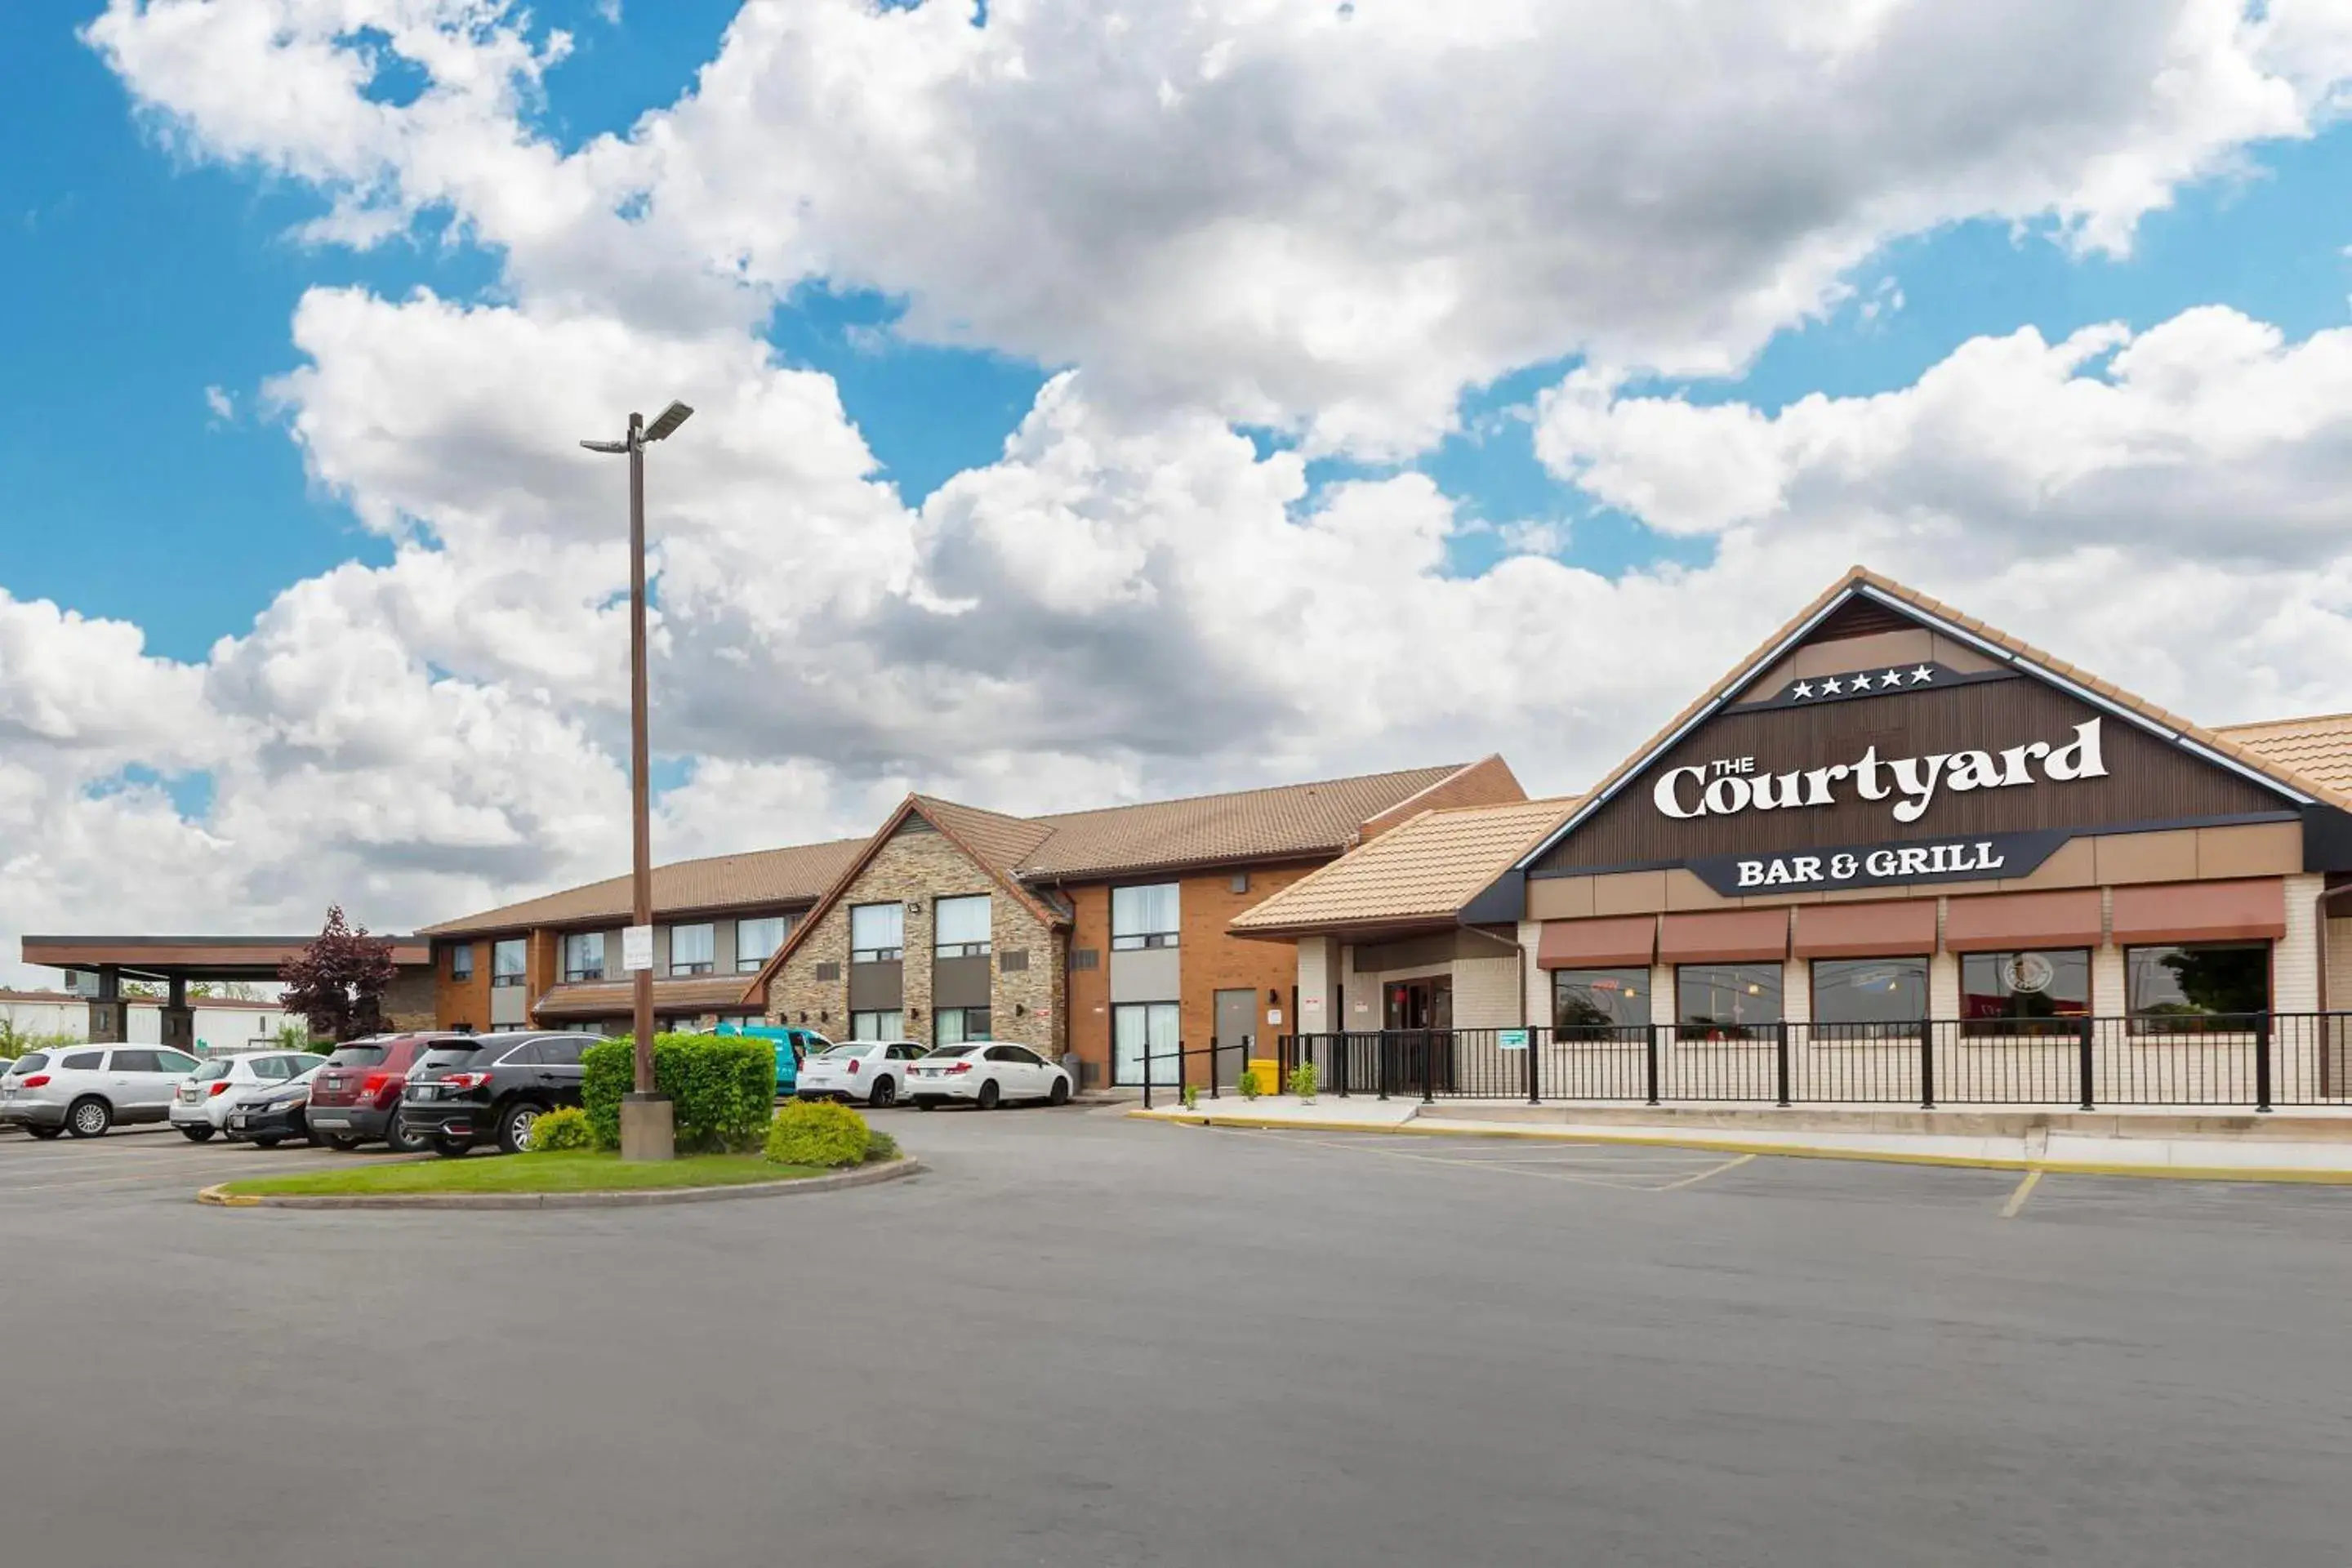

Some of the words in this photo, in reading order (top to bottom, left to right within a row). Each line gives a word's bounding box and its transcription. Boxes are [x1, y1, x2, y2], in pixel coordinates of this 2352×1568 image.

[1653, 717, 2109, 822] Courtyard
[1711, 756, 1755, 776] THE
[1737, 856, 1824, 887] BAR
[1831, 853, 1859, 879] &
[1865, 842, 2004, 876] GRILL
